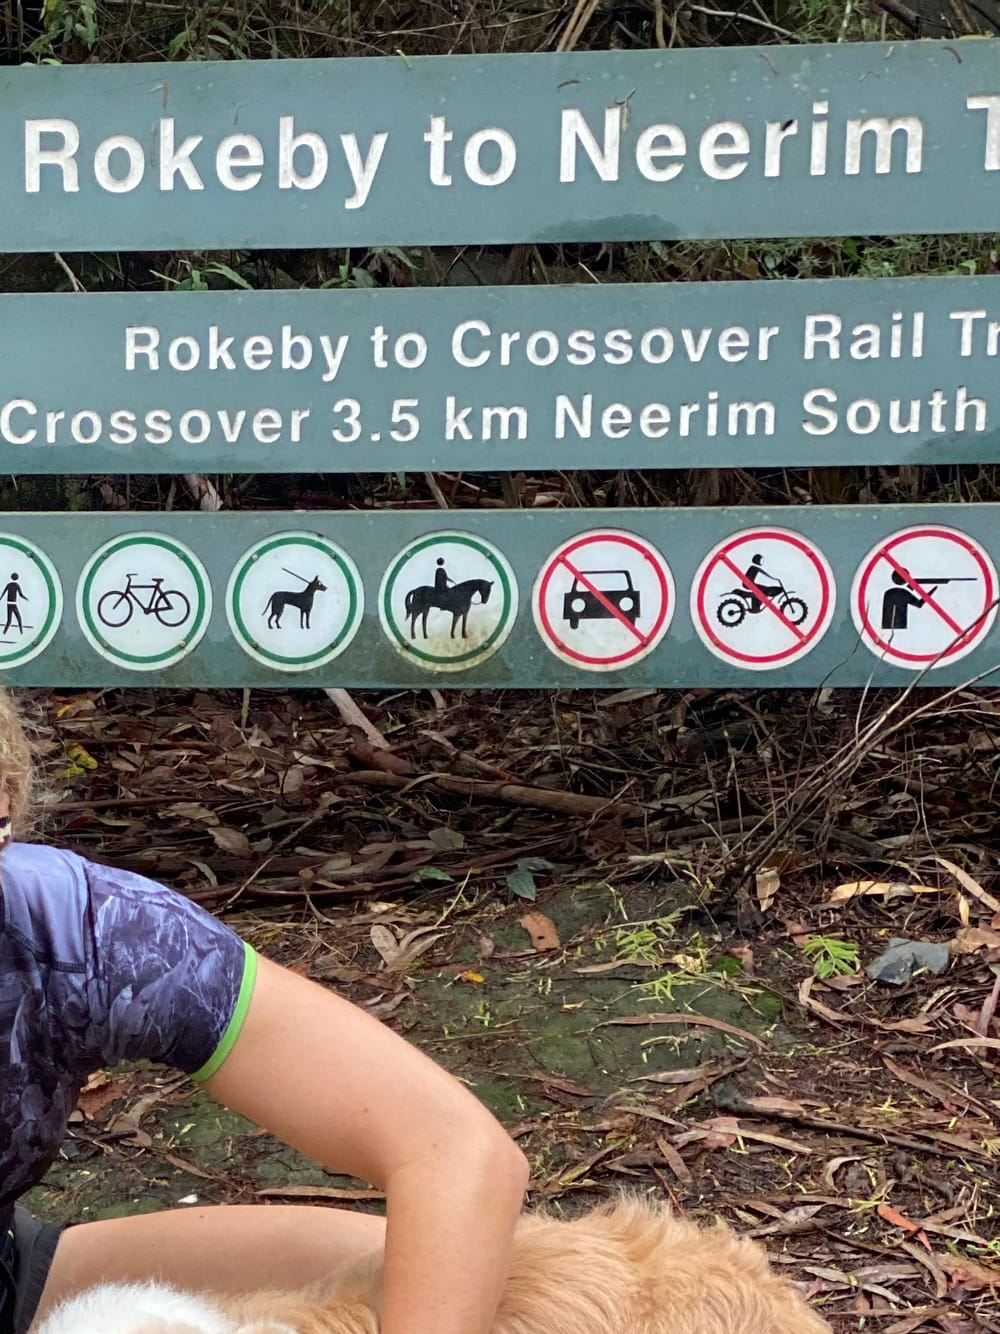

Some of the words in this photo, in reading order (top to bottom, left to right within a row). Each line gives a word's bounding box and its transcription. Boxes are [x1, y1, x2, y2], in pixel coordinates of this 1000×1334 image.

[23, 114, 390, 211] Rokeby
[422, 113, 518, 188] to
[558, 99, 925, 184] Neerim
[124, 323, 351, 383] Rokeby
[369, 324, 429, 370] to
[450, 318, 781, 369] Crossover
[802, 310, 925, 361] Rail
[330, 397, 421, 444] 3.5
[444, 394, 529, 442] km
[553, 390, 777, 440] Neerim
[801, 385, 988, 437] South
